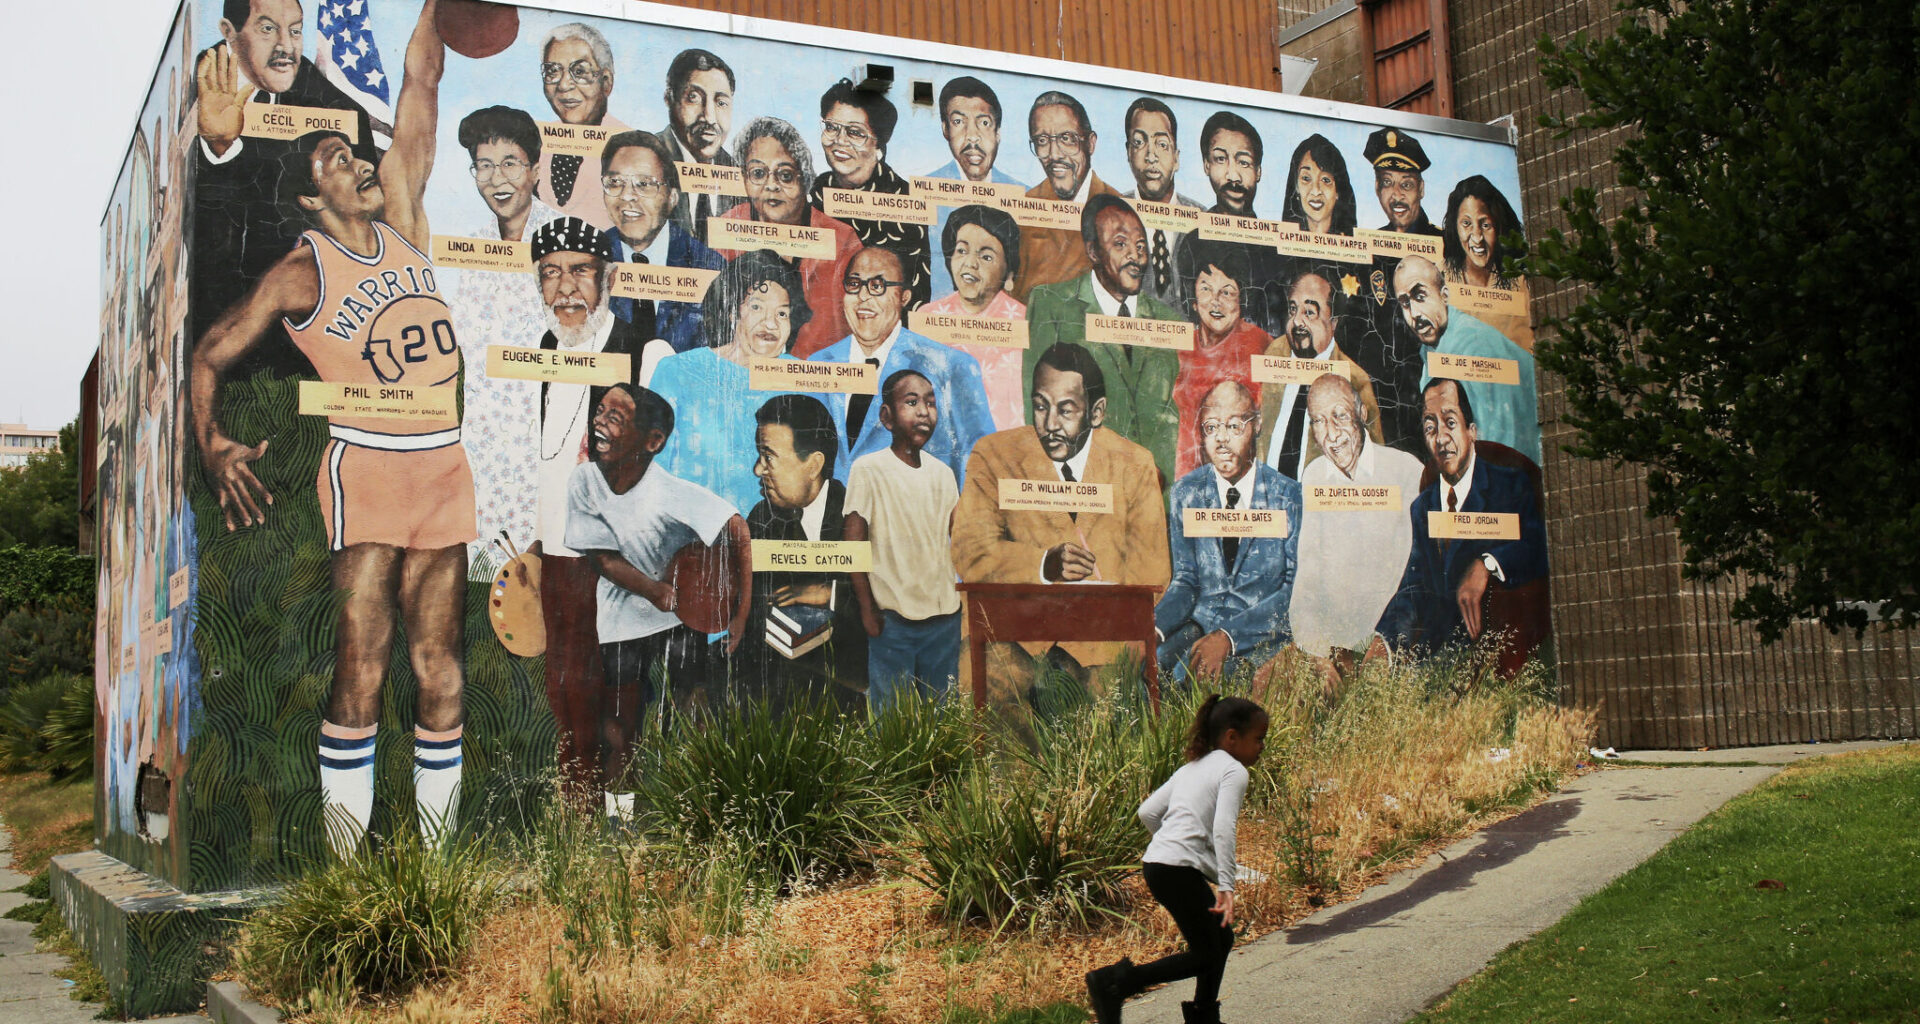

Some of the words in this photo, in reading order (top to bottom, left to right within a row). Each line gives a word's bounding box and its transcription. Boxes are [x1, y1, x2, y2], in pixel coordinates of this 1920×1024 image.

[263, 114, 294, 126] CECIL
[306, 118, 342, 130] POOLE
[544, 126, 574, 138] NAOMI
[583, 130, 607, 140] GRAY
[681, 166, 708, 178] EARL
[711, 170, 740, 181] WHITE
[914, 180, 934, 191] WILL
[939, 182, 965, 194] HENRY
[972, 186, 995, 196] RENO
[832, 193, 864, 204] ORELIA
[872, 196, 926, 210] LANSGSTON
[1000, 198, 1048, 212] NATHANIAL
[1052, 204, 1080, 214] MASON
[1136, 203, 1170, 216] RICHARD
[1174, 208, 1198, 220] FINNIS
[1210, 216, 1230, 226] ISIAH
[1237, 220, 1270, 231] NELSON
[726, 222, 778, 237] DONNETER
[789, 230, 820, 241] LANE
[1280, 232, 1310, 242] CAPTAIN
[1314, 236, 1338, 246] SYLVIA
[1340, 239, 1367, 250] HARPER
[1373, 240, 1402, 250] RICHARD
[1408, 243, 1436, 254] HOLDER
[448, 241, 474, 252] LINDA
[484, 244, 513, 256] DAVIS
[638, 274, 670, 286] WILLIS
[678, 277, 698, 288] KIRK
[1460, 288, 1472, 296] EVA
[1478, 290, 1512, 301] PATTERSON
[324, 266, 437, 342] WARRIO
[926, 317, 956, 328] AILEEN
[962, 319, 1012, 332] HERNANDEZ
[1156, 323, 1187, 334] HECTOR
[401, 320, 458, 364] 20
[976, 334, 1010, 343] CONSULTANT
[502, 350, 544, 364] EUGENE
[564, 356, 596, 368] WHITE
[1264, 358, 1291, 369] CLAUDE
[1456, 358, 1467, 367] JOE
[1472, 360, 1502, 370] MARSHALL
[787, 364, 831, 376] BENJAMIN
[836, 366, 864, 378] SMITH
[796, 380, 820, 388] PARENTS
[344, 387, 370, 398] PHIL
[380, 388, 414, 400] SMITH
[1037, 484, 1072, 494] WILLIAM
[1076, 486, 1098, 495] COBB
[1329, 488, 1358, 497] ZURETTA
[1362, 488, 1388, 497] GOOSBY
[1211, 512, 1240, 522] ERNEST
[1252, 512, 1272, 522] BATES
[1454, 515, 1470, 524] FRED
[1474, 516, 1498, 524] JORDAN
[771, 554, 807, 565] REVELS
[815, 555, 852, 565] CAYTON
